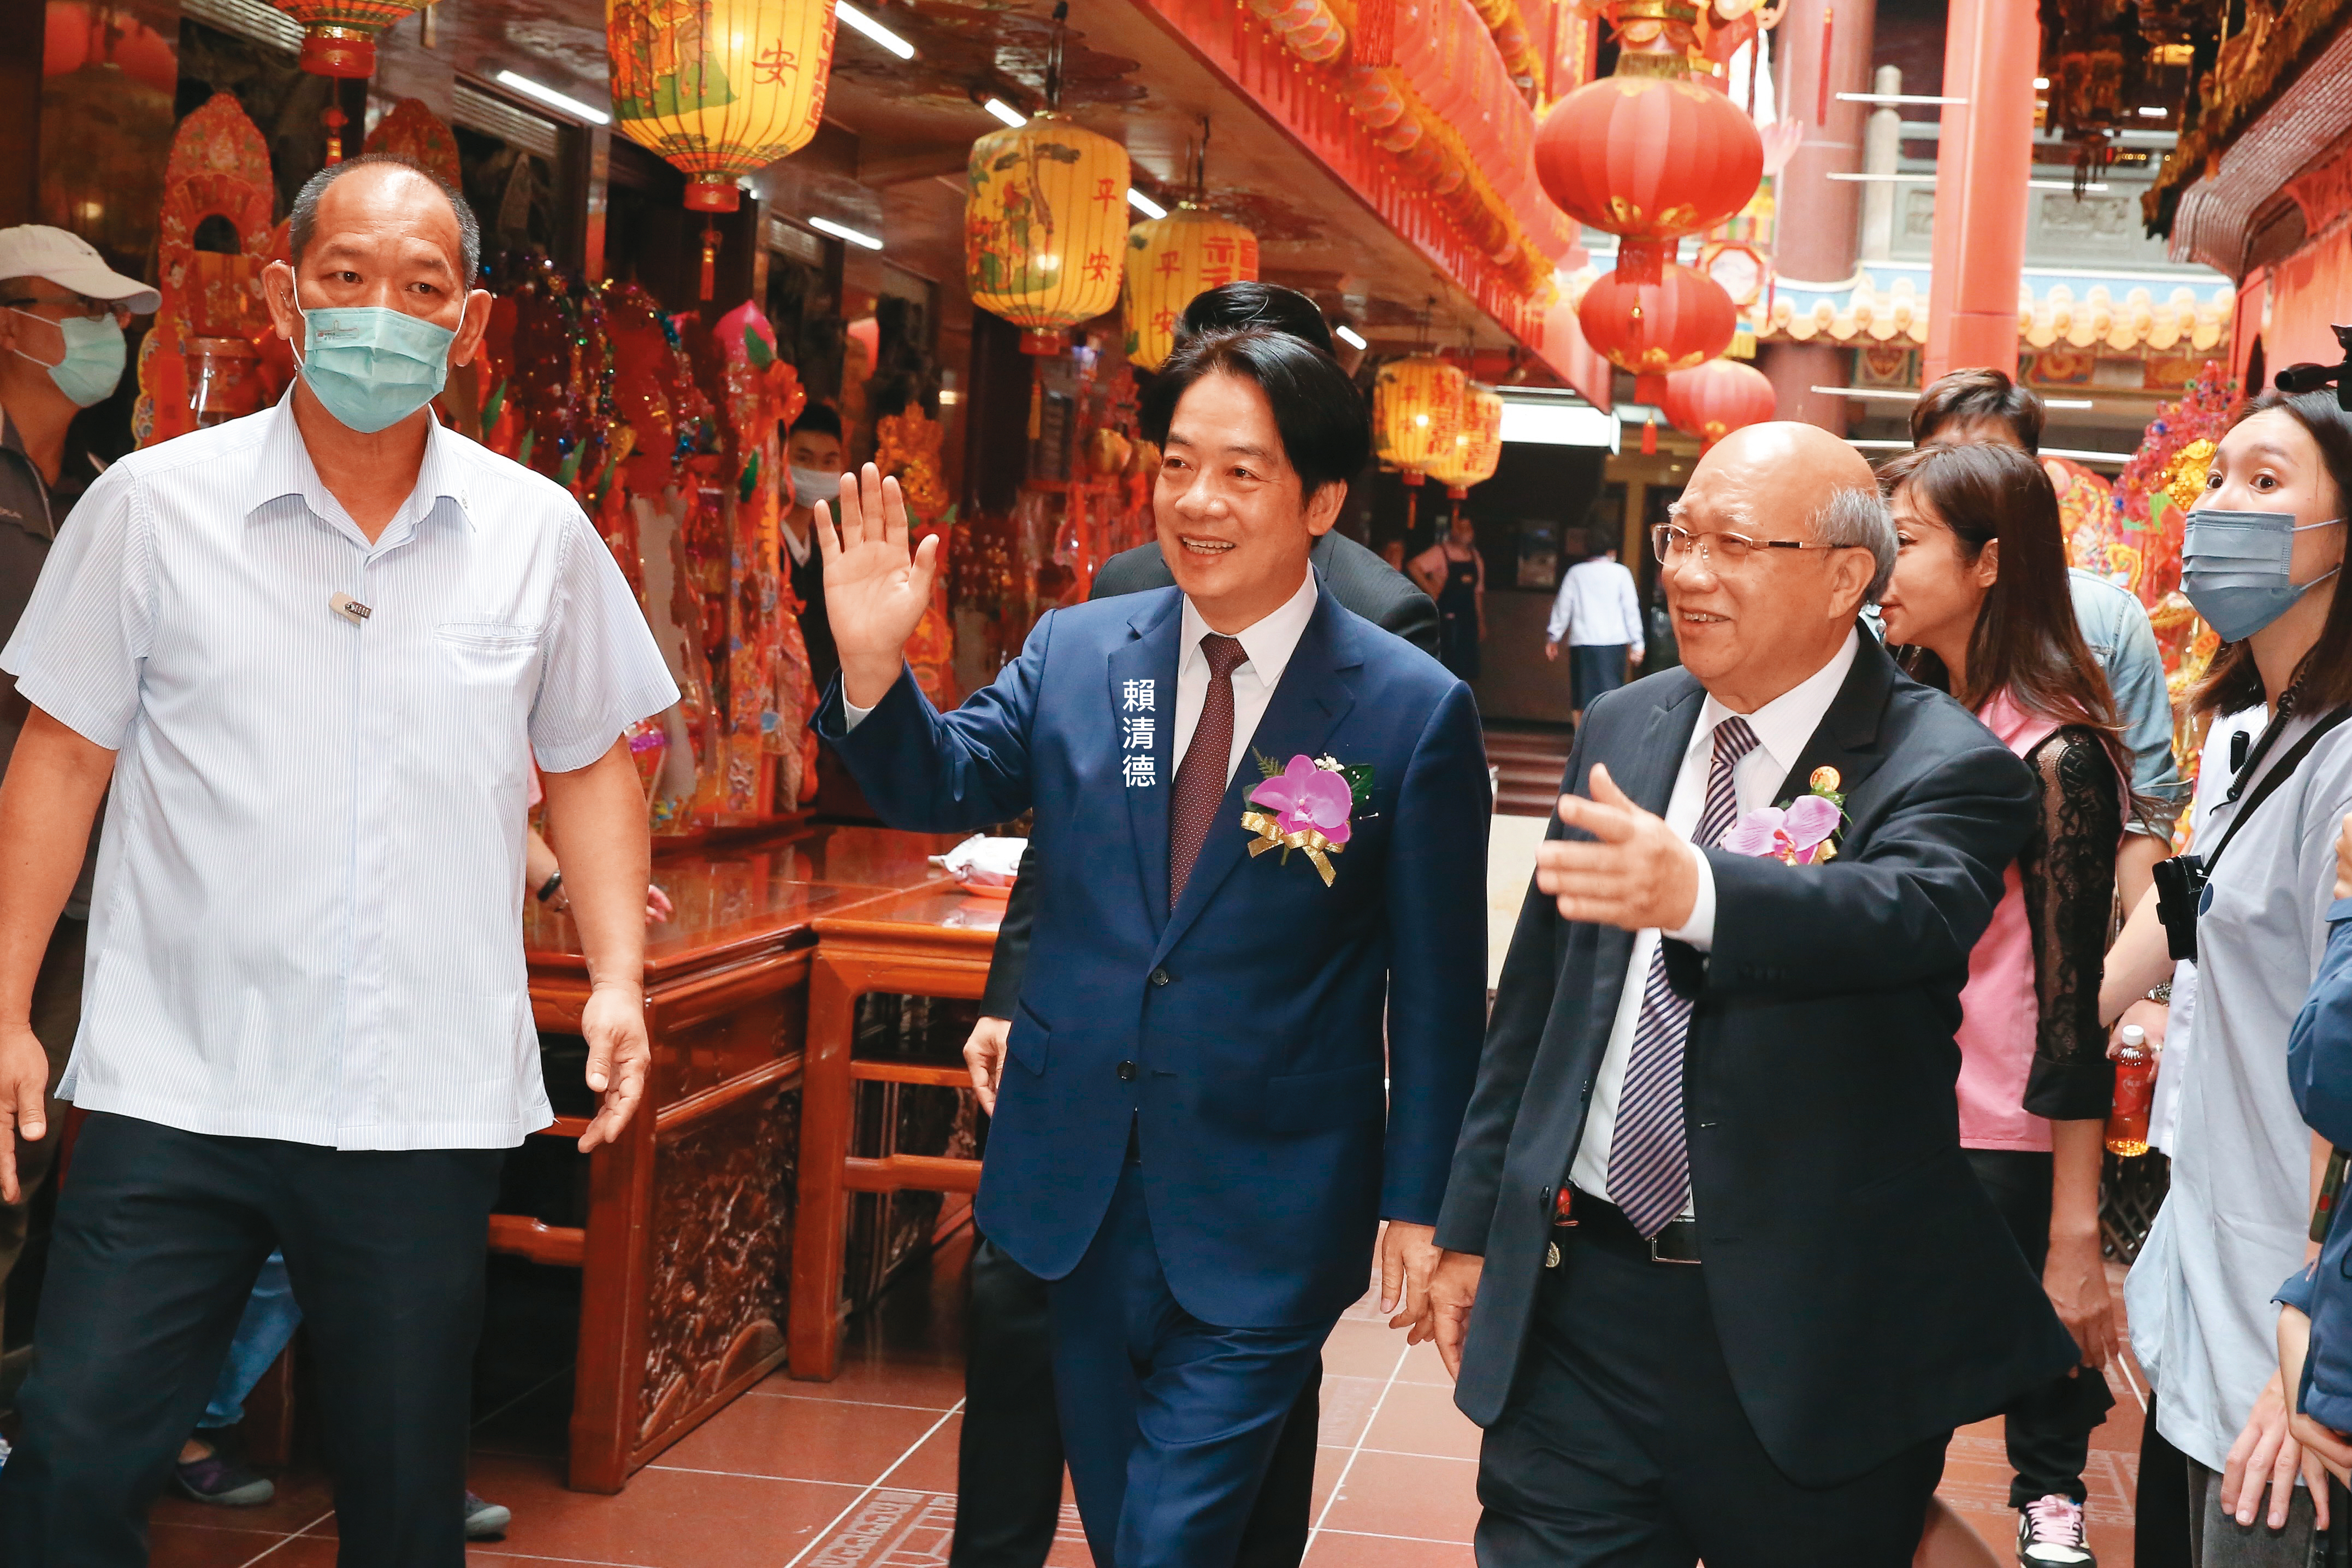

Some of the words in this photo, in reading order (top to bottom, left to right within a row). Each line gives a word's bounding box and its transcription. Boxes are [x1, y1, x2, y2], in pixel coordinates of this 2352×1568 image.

[751, 38, 799, 88] 安
[1081, 177, 1118, 282] 平安
[1149, 250, 1181, 337] 平安
